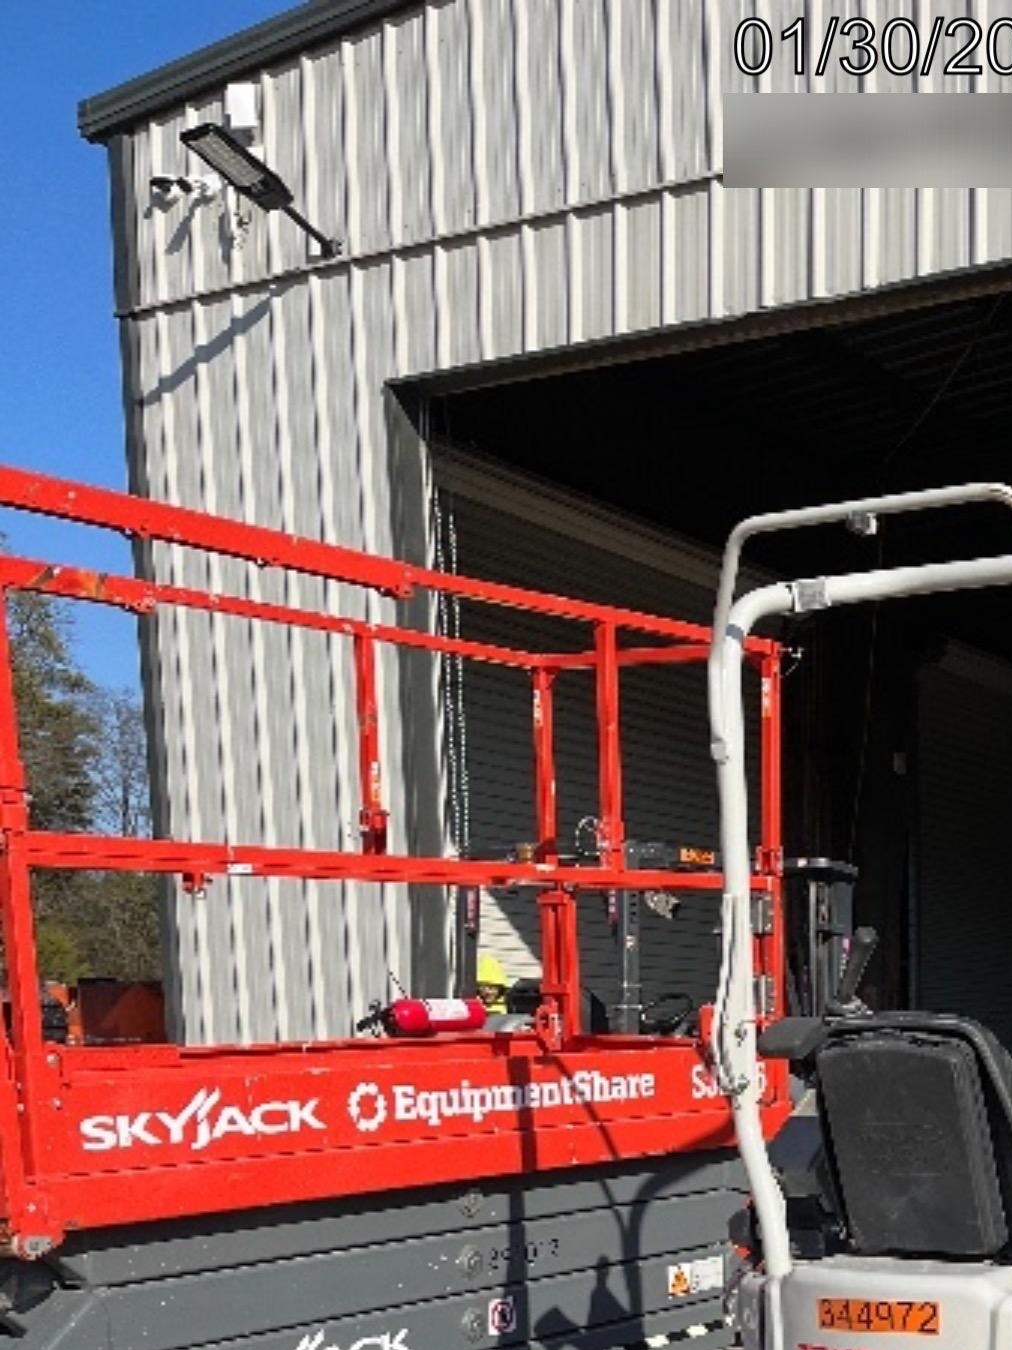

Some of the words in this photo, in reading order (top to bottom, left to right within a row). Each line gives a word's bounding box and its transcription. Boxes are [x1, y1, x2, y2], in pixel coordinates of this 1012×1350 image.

[79, 1086, 328, 1150] SKYJACK
[392, 1070, 656, 1127] EquipmentShare
[820, 1299, 939, 1335] 344972
